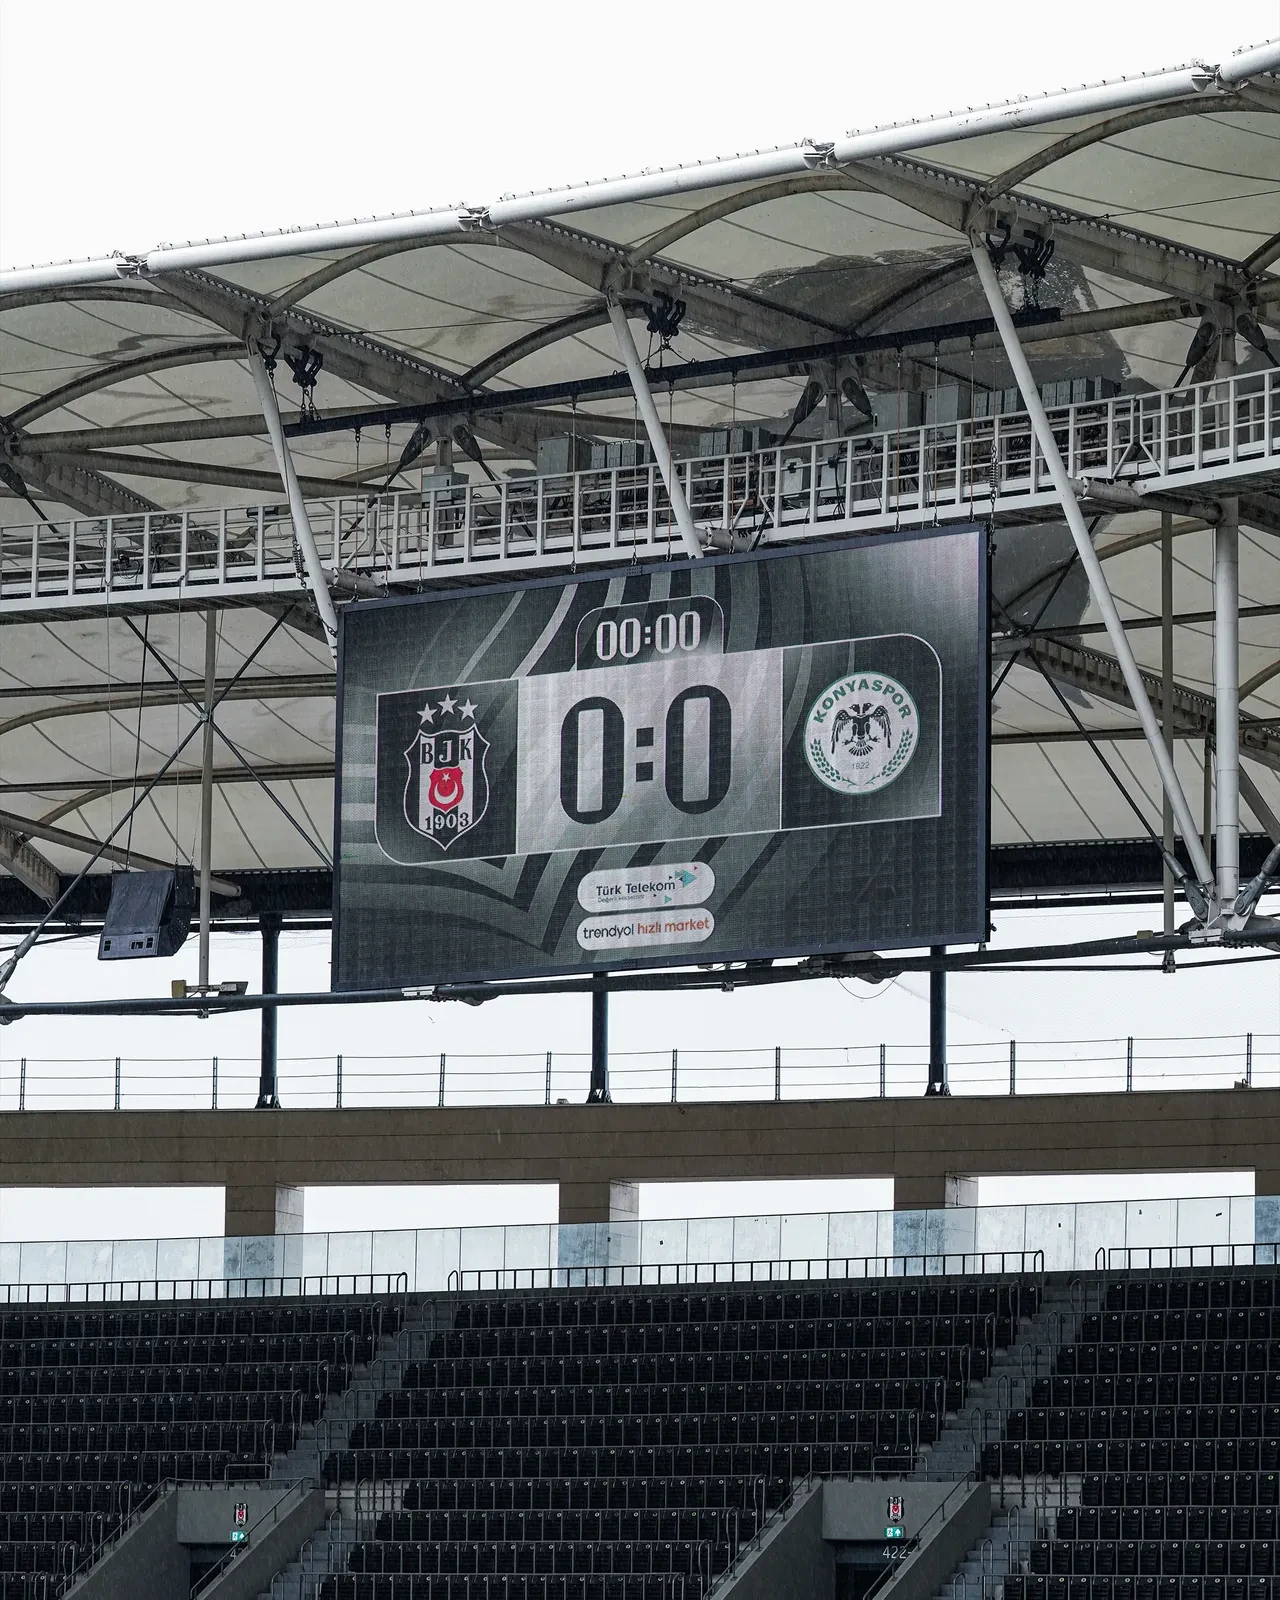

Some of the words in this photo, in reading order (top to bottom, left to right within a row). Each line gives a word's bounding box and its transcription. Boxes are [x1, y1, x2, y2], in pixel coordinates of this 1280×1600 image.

[597, 611, 700, 660] 00:00
[813, 679, 912, 723] KONYASPOR
[420, 737, 472, 765] BJK
[560, 684, 732, 825] 0:0
[851, 761, 870, 770] 1922
[424, 812, 470, 831] 1903
[596, 884, 622, 896] Türk
[625, 881, 676, 894] Telekom
[583, 923, 634, 939] trendyol
[664, 917, 710, 932] market
